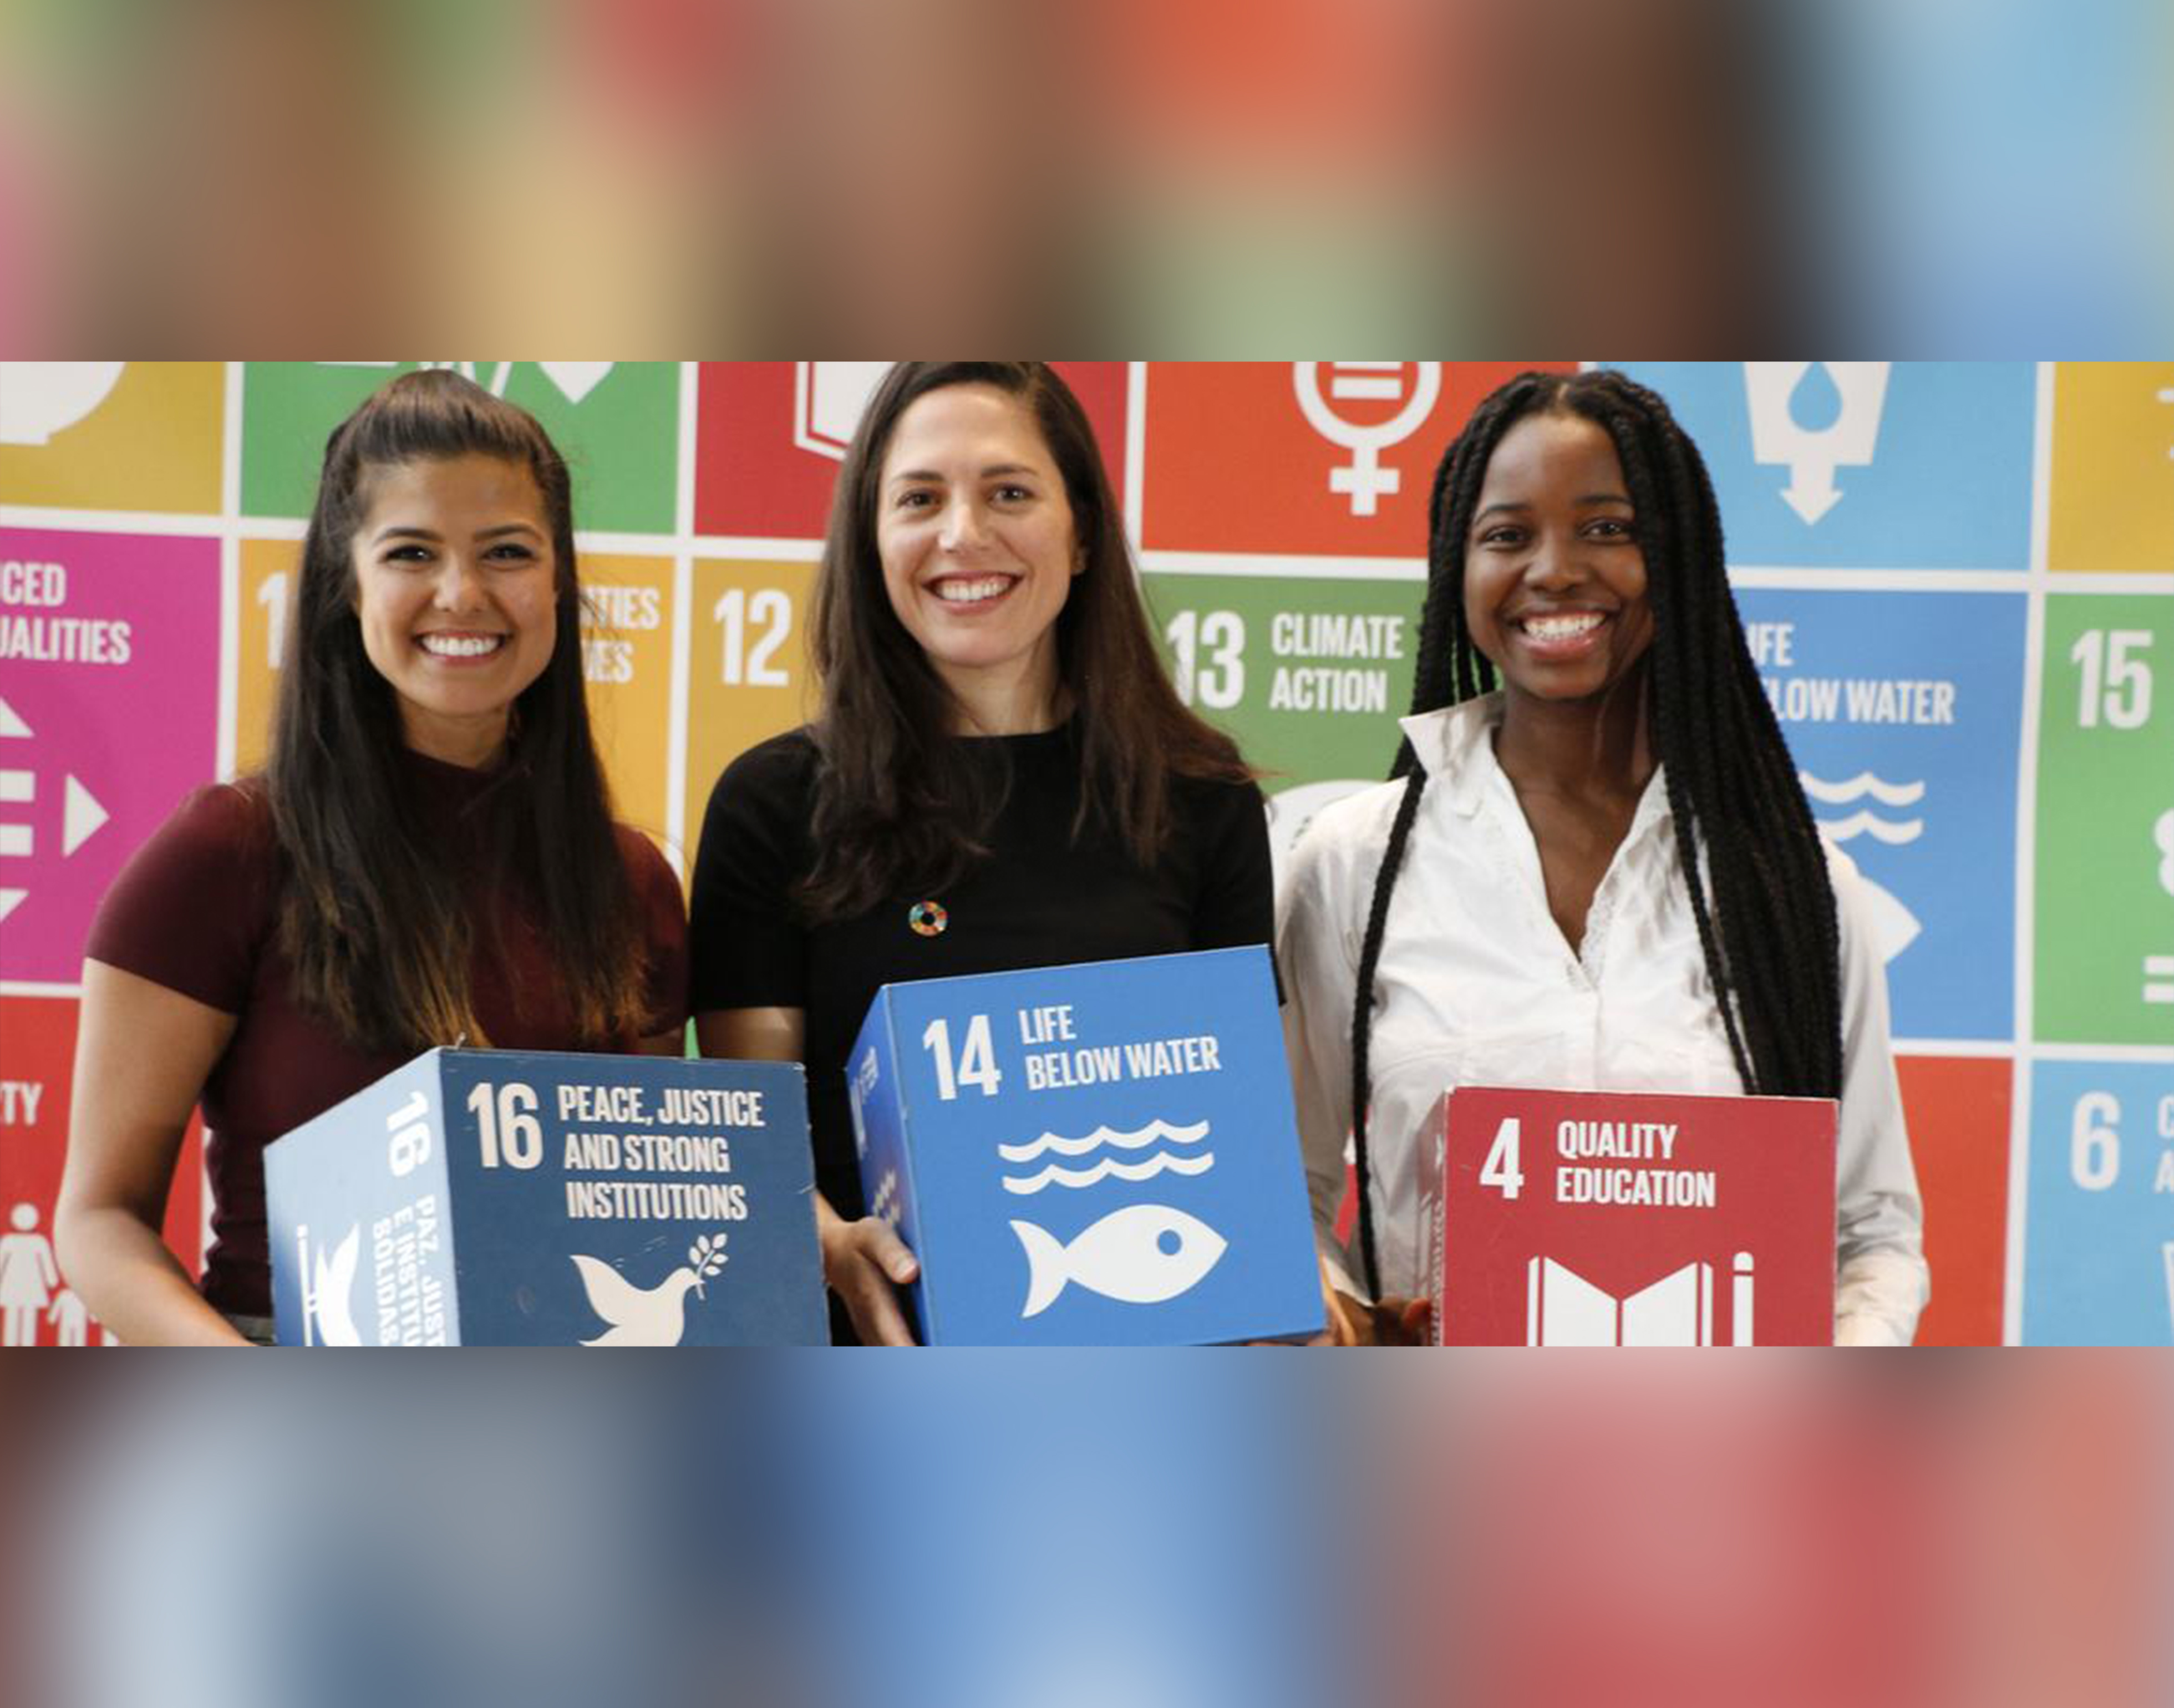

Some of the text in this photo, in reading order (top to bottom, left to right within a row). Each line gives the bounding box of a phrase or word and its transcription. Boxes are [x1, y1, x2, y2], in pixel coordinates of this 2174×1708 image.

[0, 561, 67, 606] CED
[714, 588, 791, 687] 12
[1272, 613, 1405, 659] CLIMATE
[1167, 610, 1245, 709] 13
[2071, 628, 2153, 729] 15
[1269, 667, 1386, 713] ACTION
[1761, 678, 1955, 724] LOW WATER
[1018, 1005, 1076, 1045] LIFE
[923, 1014, 1002, 1100] 14
[1025, 1036, 1222, 1091] BELOW WATER
[0, 1080, 43, 1126] TY
[468, 1082, 543, 1170] 16
[557, 1085, 765, 1127] PEACE, JUSTICE
[387, 1091, 431, 1177] 16
[565, 1133, 730, 1172] AND STRONG
[1557, 1121, 1677, 1160] QUALITY
[2071, 1091, 2120, 1192] 6
[1480, 1117, 1524, 1199] 4
[566, 1182, 748, 1221] INSTITUTIONS
[1557, 1167, 1715, 1208] EDUCATION
